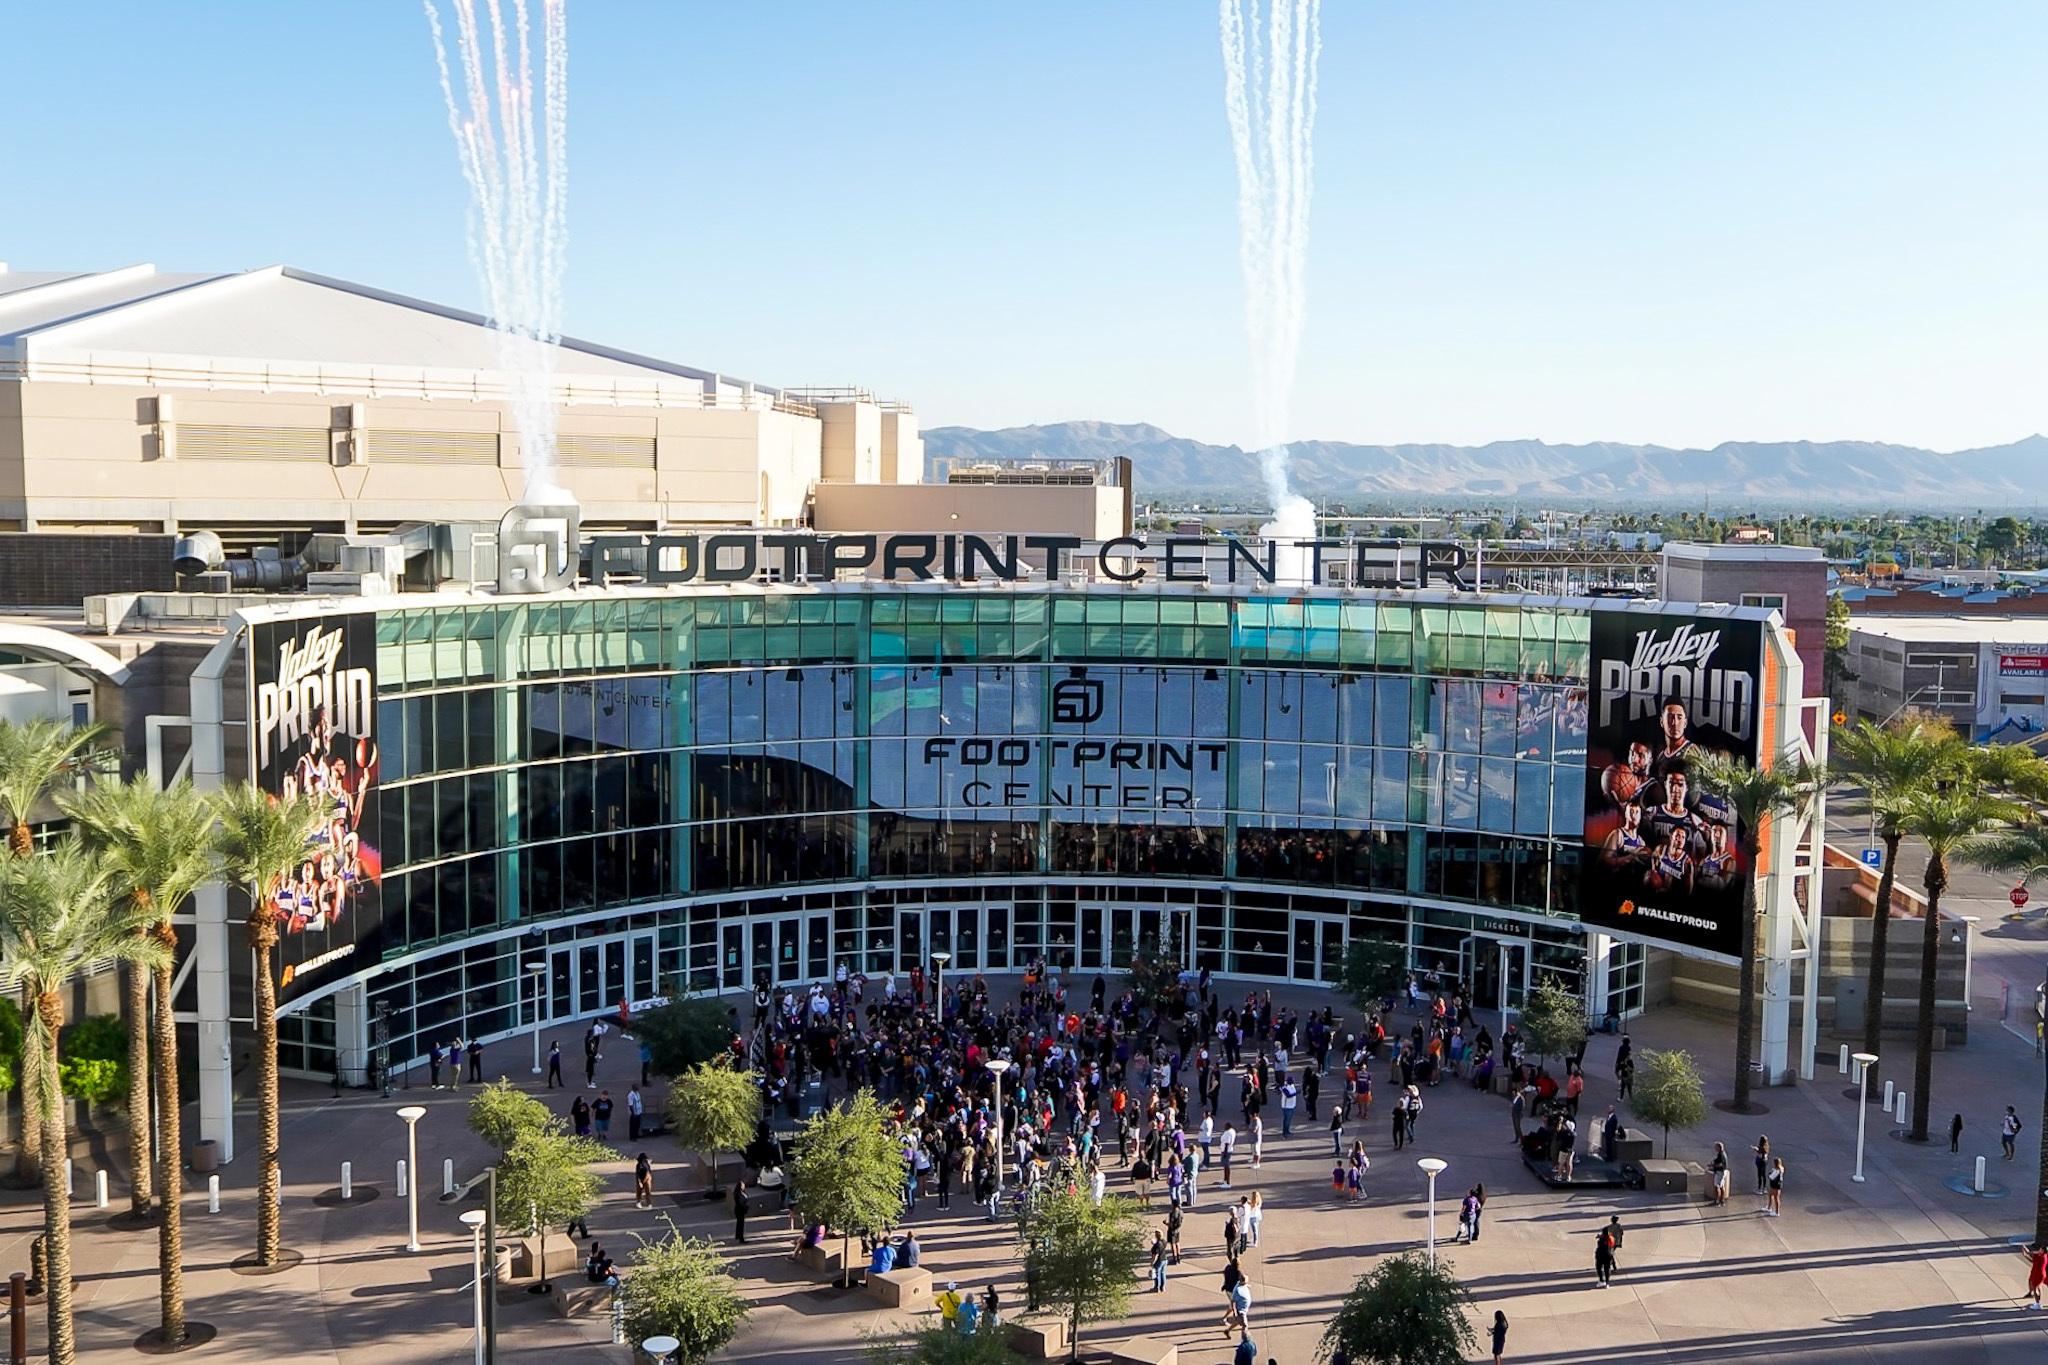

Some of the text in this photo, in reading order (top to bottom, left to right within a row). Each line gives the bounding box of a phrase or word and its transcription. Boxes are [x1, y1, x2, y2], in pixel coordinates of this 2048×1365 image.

[591, 535, 1475, 592] FOOTPRINT CENTER
[279, 624, 344, 692] Valley
[1631, 623, 1721, 671] Valley
[2002, 669, 2045, 677] AVAILABLE
[1599, 659, 1754, 742] PROUD
[258, 667, 372, 771] PROUD
[924, 738, 1228, 771] FOOTPRINT
[962, 781, 1194, 813] CENTER
[1500, 840, 1564, 852] TICKES
[1867, 851, 1877, 862] P
[2010, 892, 2028, 900] STOP
[1637, 905, 1718, 931] #VALLEYPROUD
